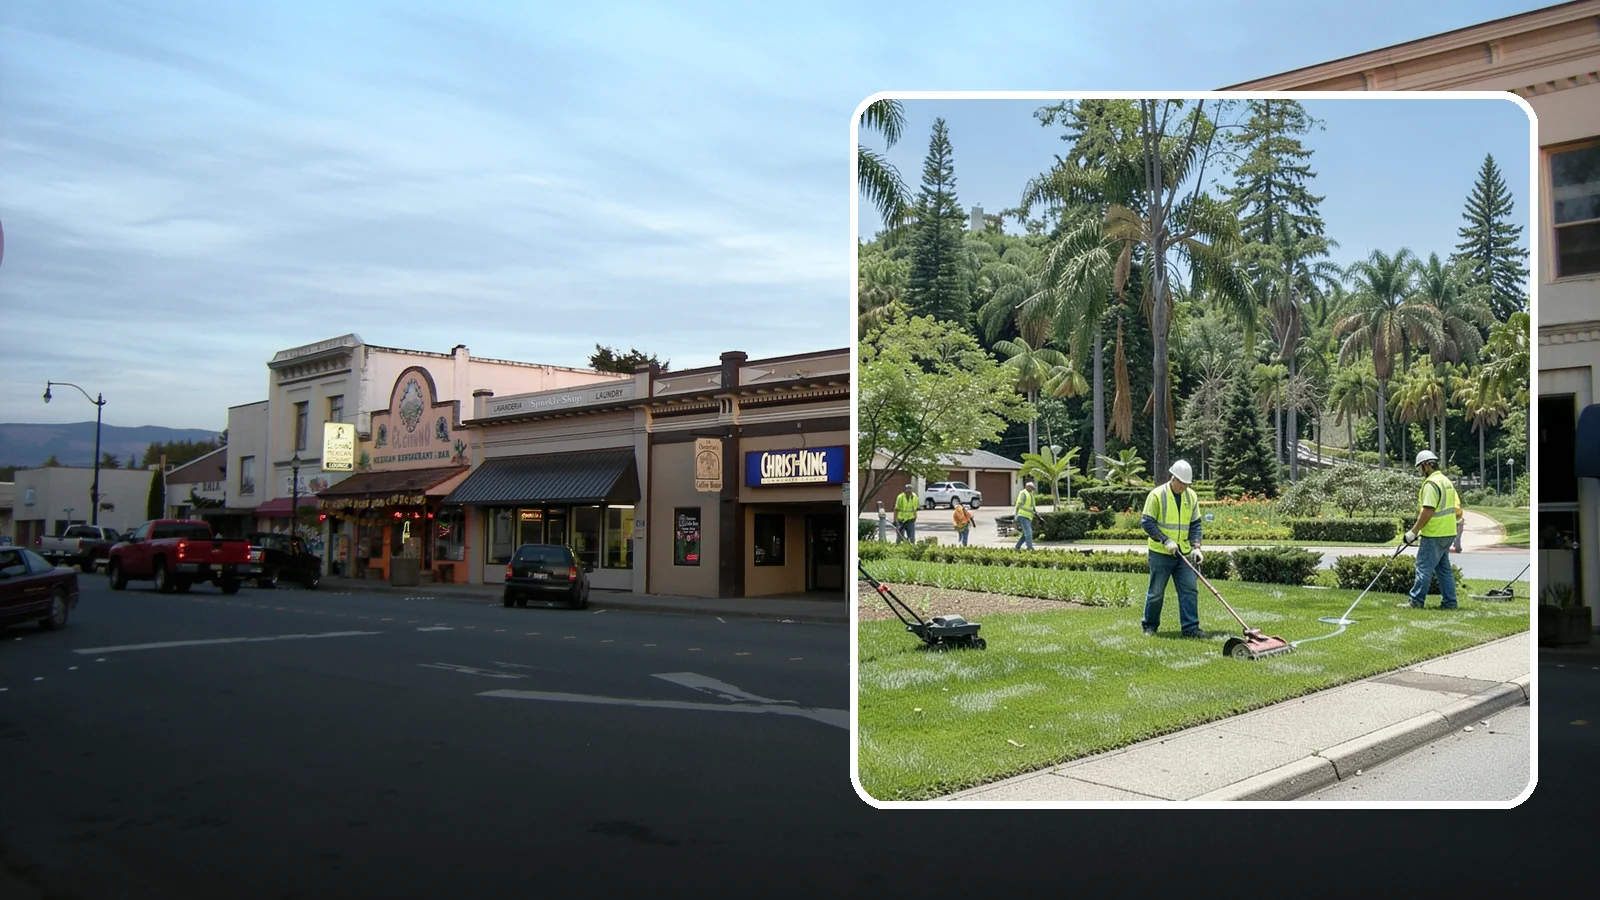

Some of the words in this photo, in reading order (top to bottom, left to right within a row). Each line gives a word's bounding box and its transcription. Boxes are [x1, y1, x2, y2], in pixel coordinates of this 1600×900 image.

[493, 402, 522, 412] LAVANDERIA
[595, 389, 624, 400] LAUNDRY
[373, 455, 396, 464] MEXICAN
[397, 451, 434, 462] RESTAURANT
[438, 450, 450, 459] BAR
[760, 452, 797, 478] CHRIST
[799, 450, 828, 477] KING
